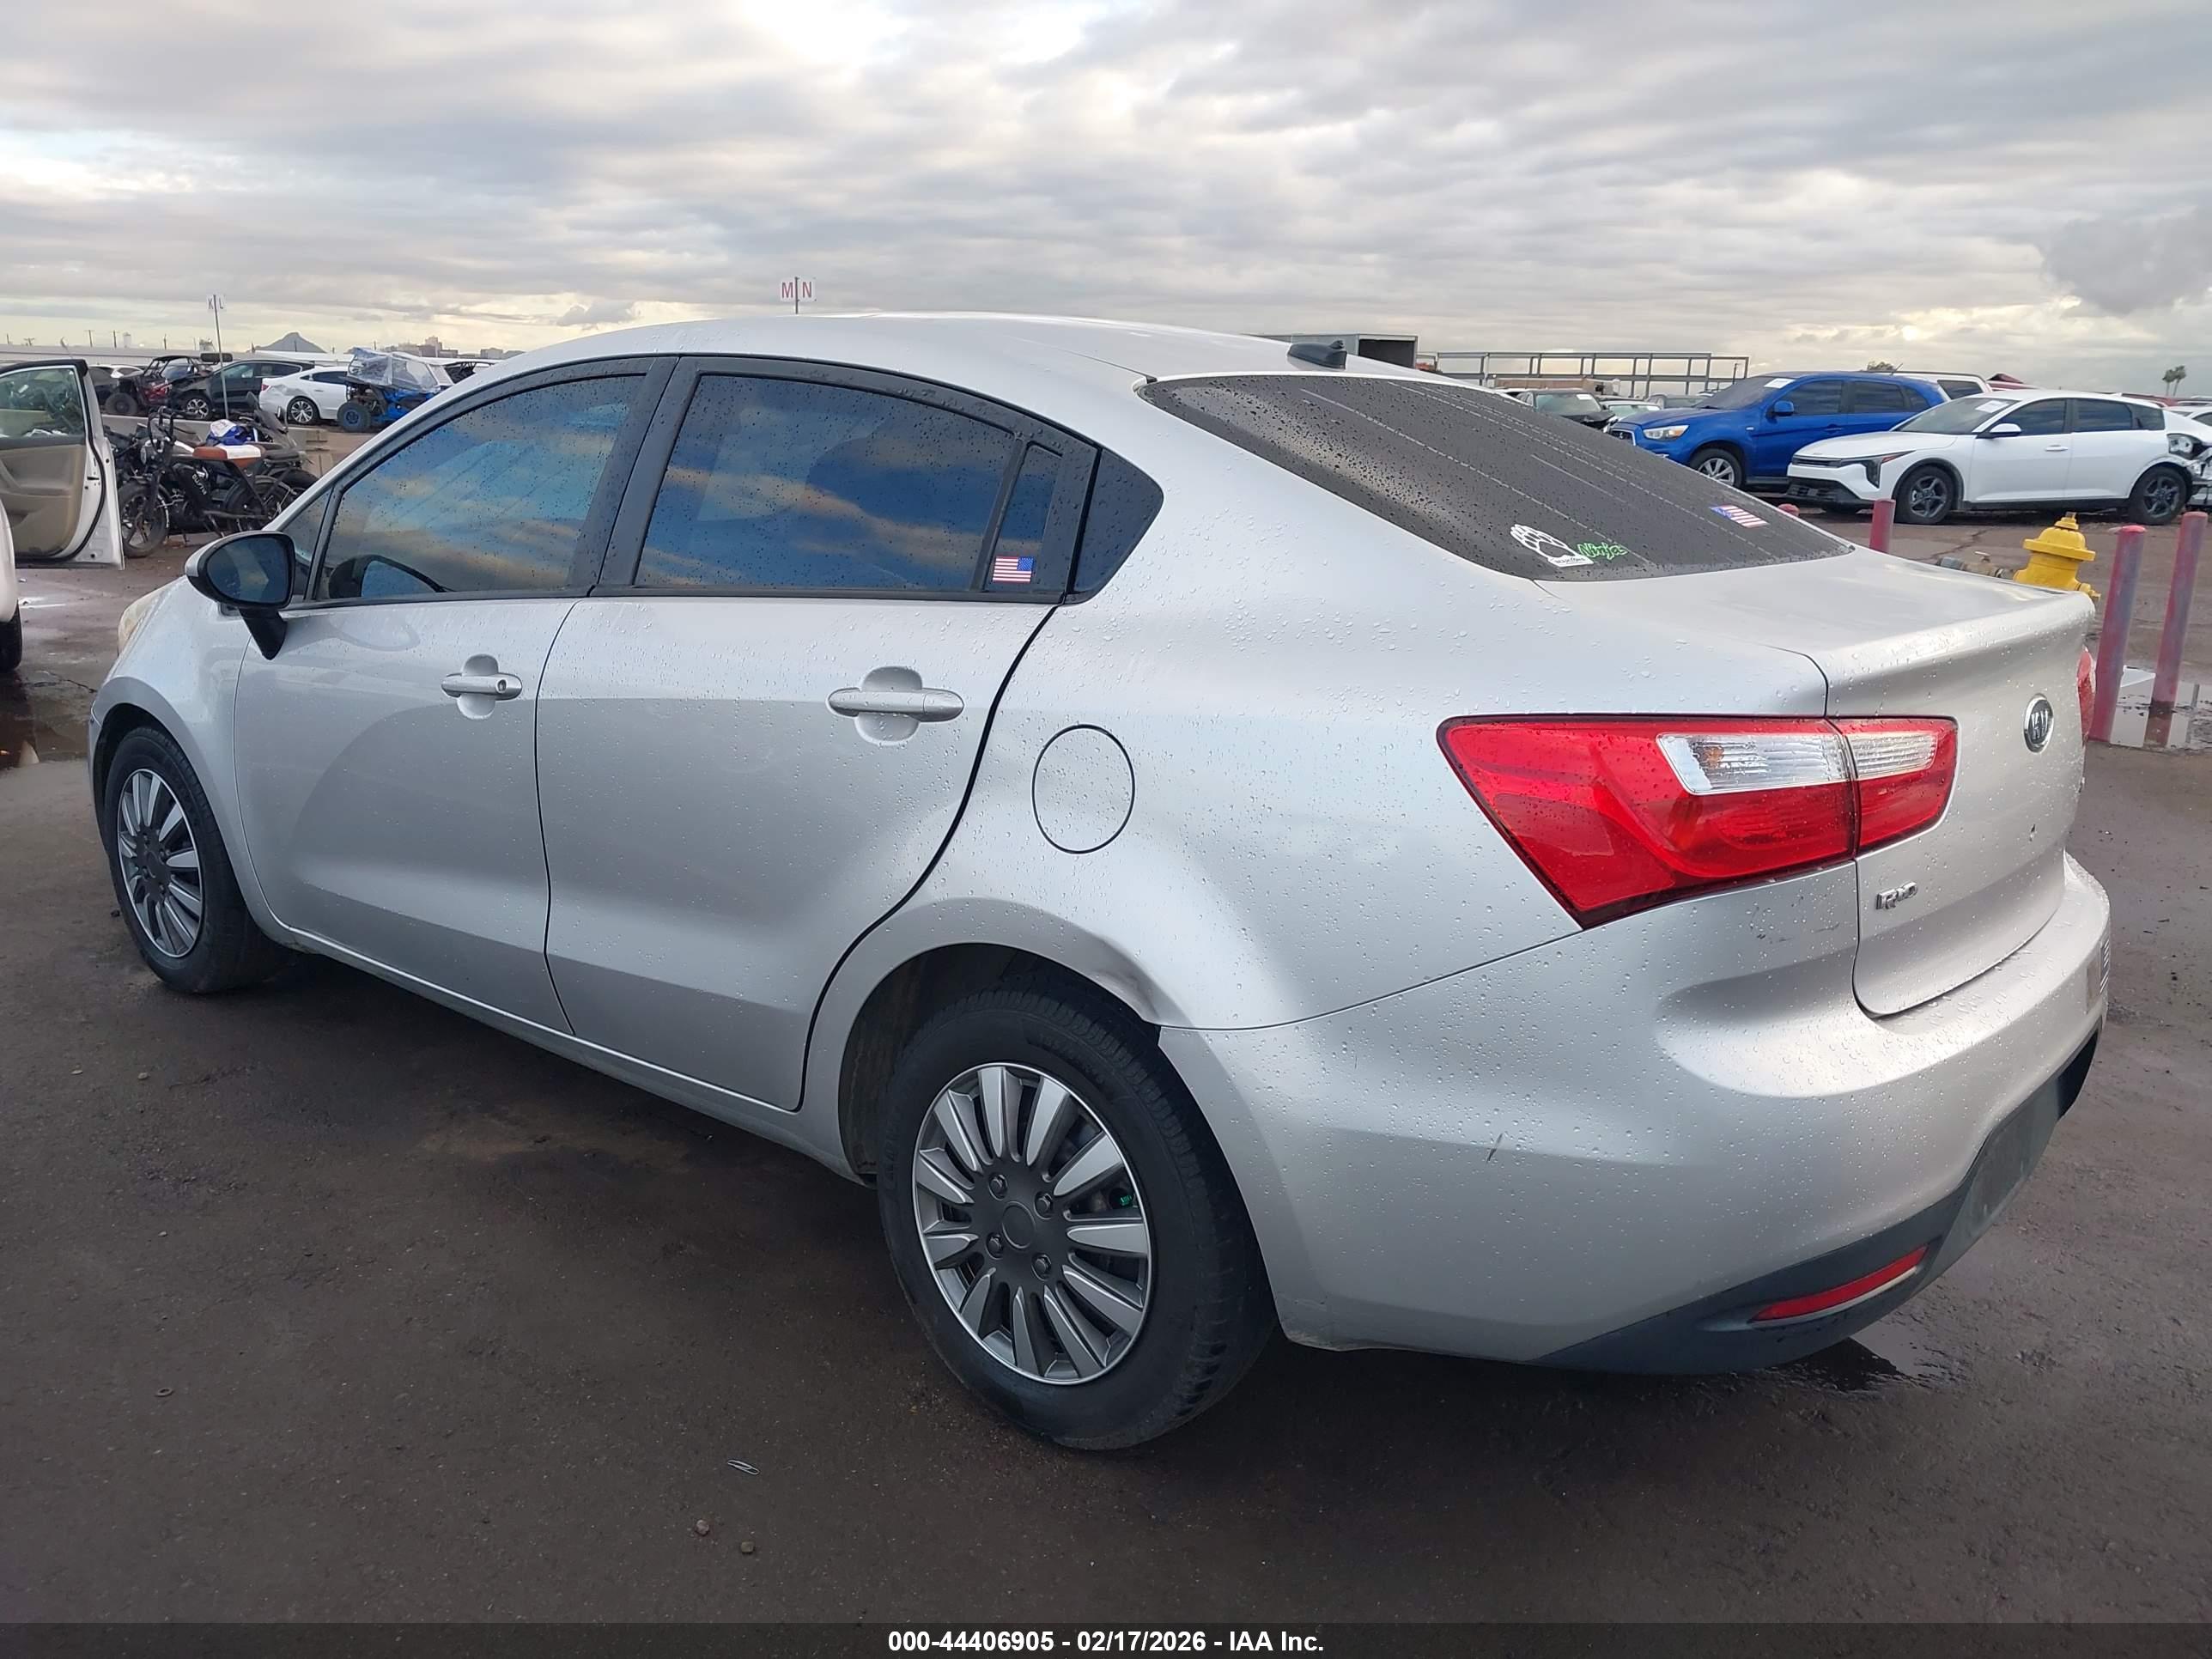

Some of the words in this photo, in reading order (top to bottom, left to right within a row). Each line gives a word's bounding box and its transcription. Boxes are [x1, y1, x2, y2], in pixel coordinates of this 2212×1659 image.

[781, 282, 793, 298] M
[802, 282, 812, 298] N
[1577, 542, 1628, 560] Ninja
